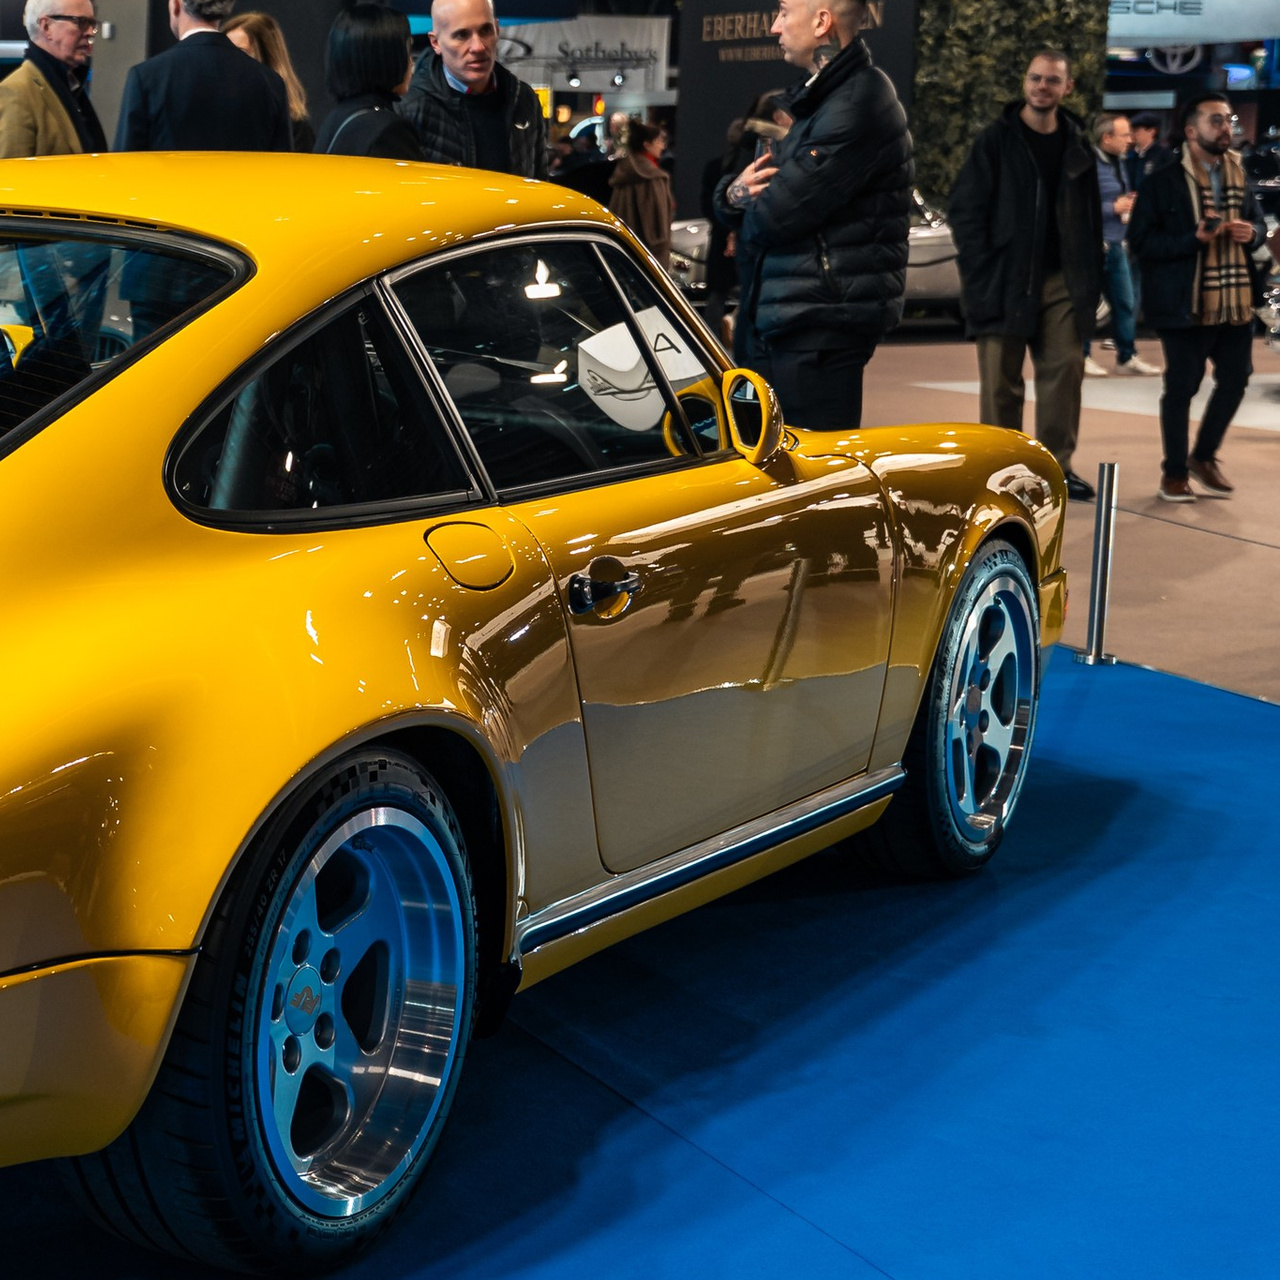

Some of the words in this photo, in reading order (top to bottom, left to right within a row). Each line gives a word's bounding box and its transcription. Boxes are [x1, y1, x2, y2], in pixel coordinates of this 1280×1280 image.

[1109, 0, 1202, 15] SCHE
[702, 9, 779, 41] EBERHA
[558, 40, 658, 64] Sotheby's
[226, 970, 250, 1144] MICHELIN
